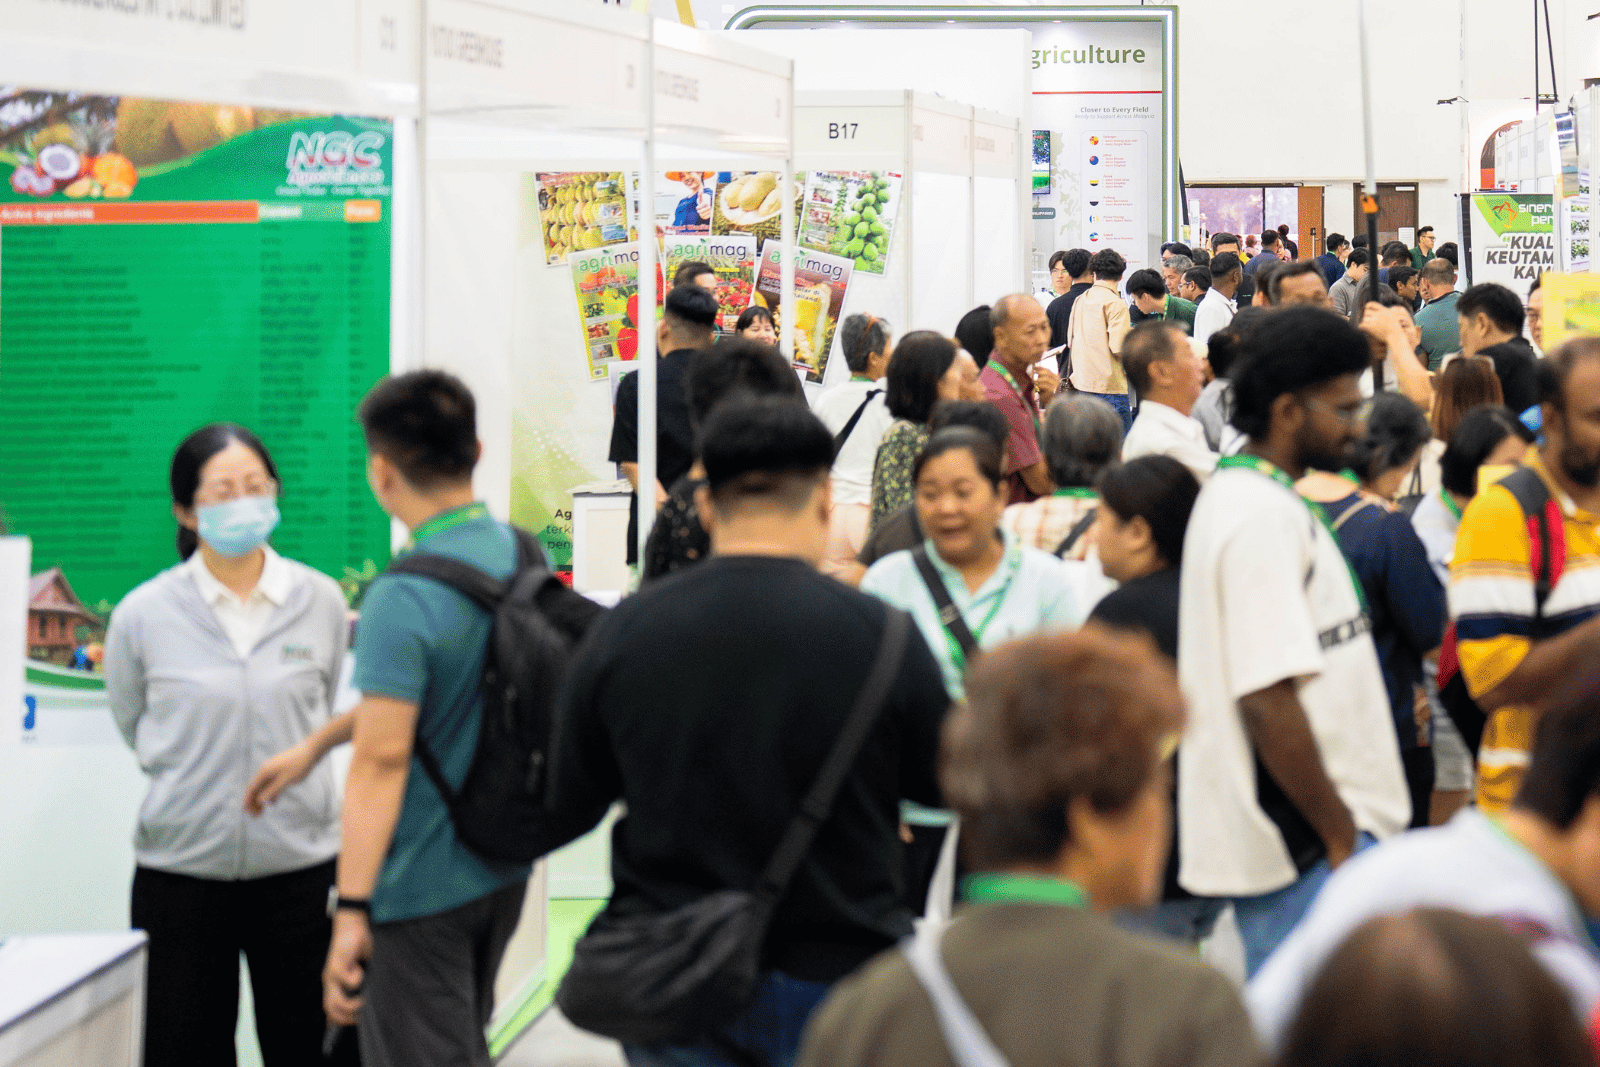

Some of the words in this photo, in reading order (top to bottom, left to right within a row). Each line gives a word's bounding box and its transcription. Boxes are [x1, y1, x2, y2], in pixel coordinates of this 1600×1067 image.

[1112, 106, 1131, 114] Every
[828, 122, 859, 139] B17
[674, 240, 747, 261] agrimag
[578, 250, 639, 274] agrima
[769, 250, 843, 281] arimag
